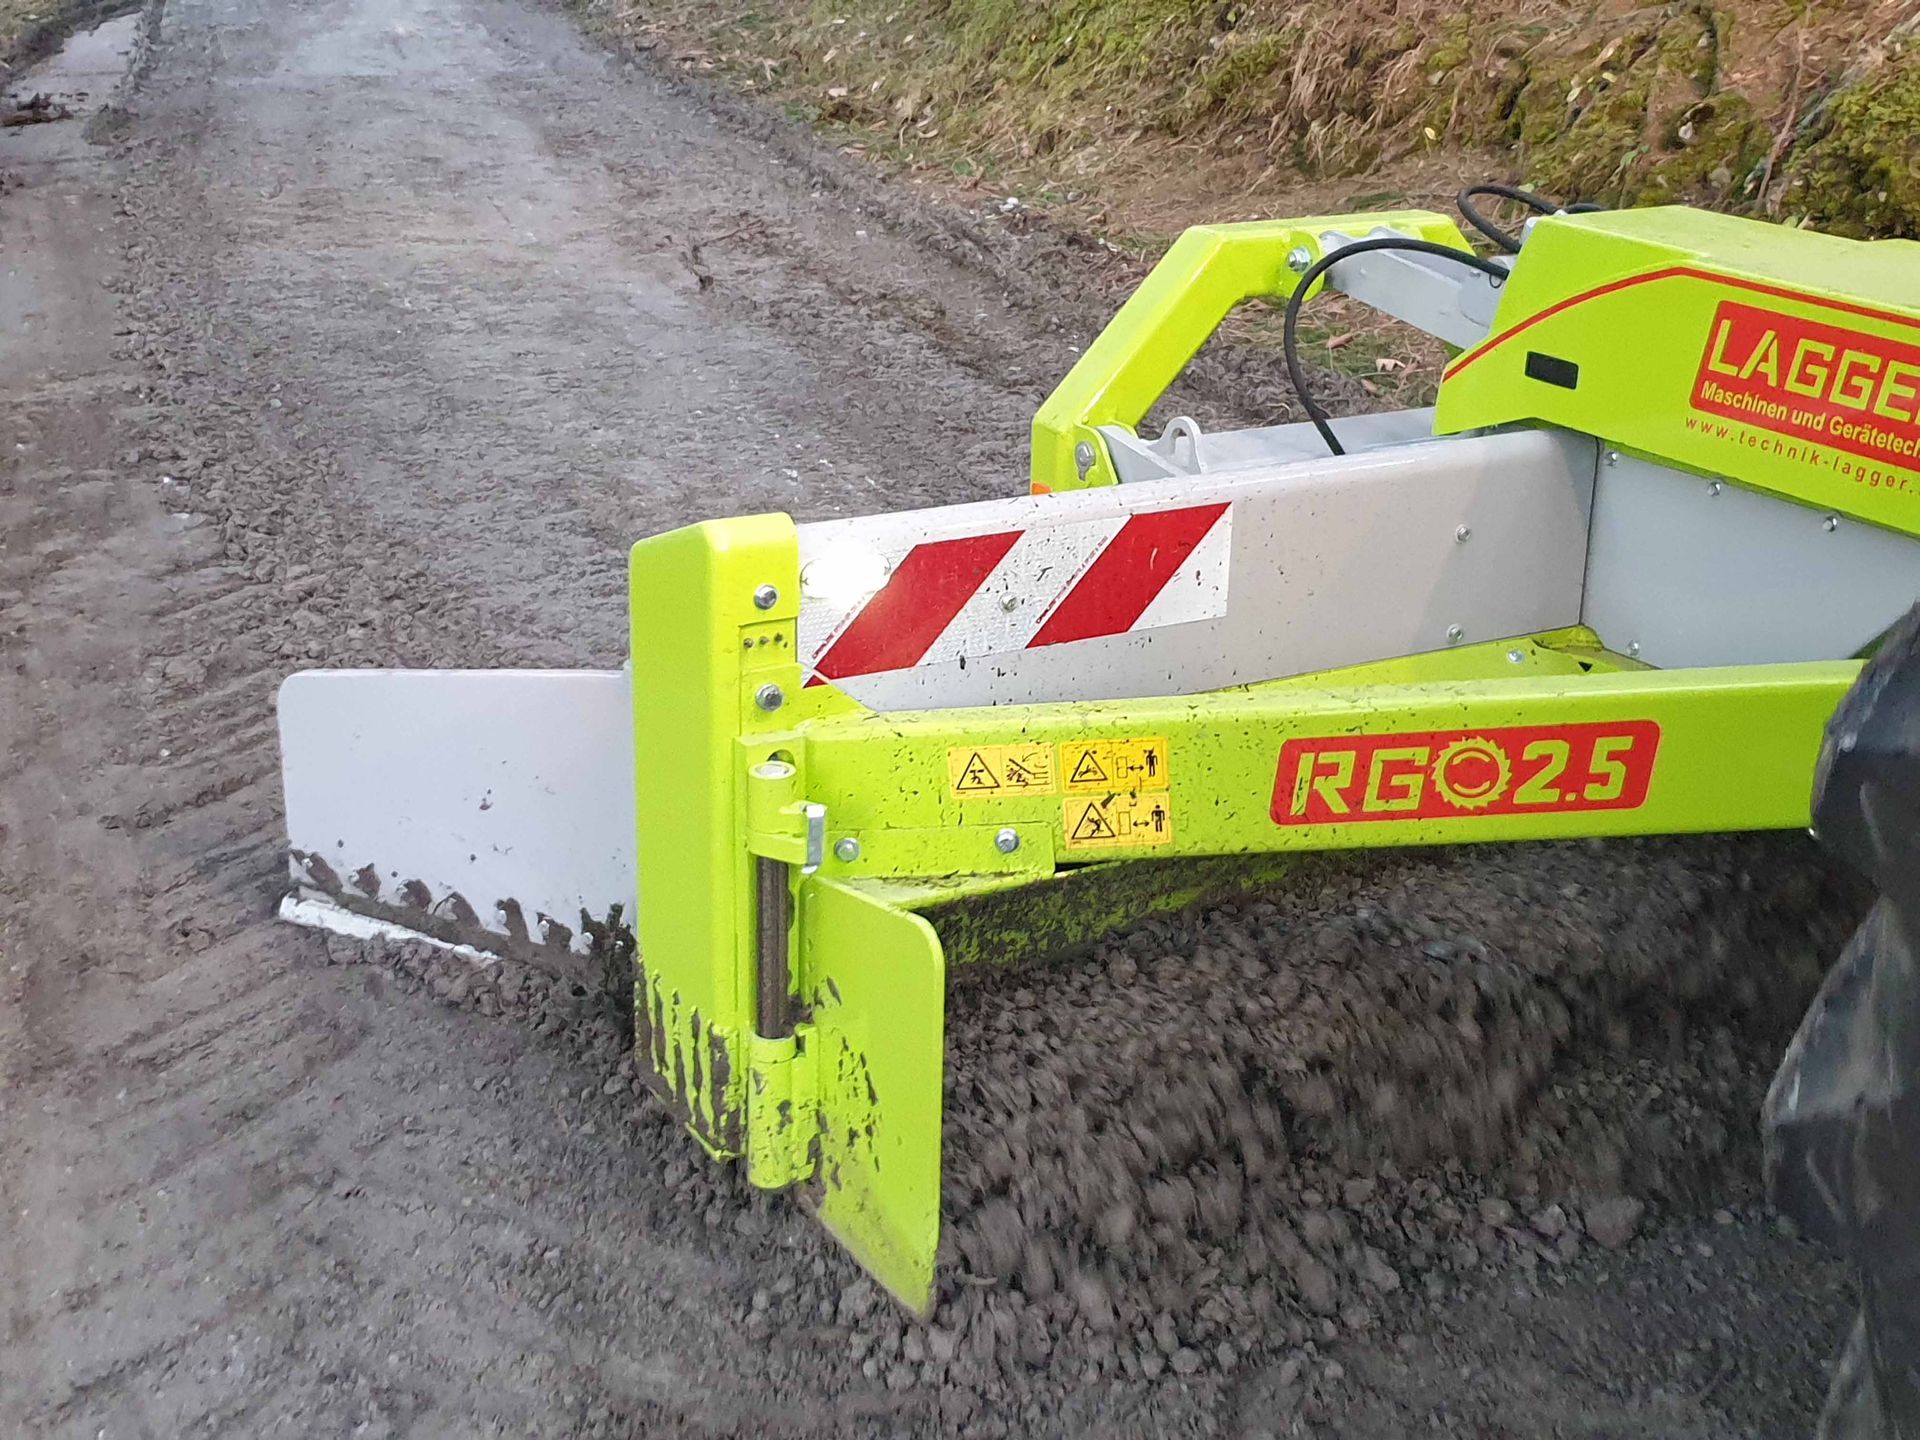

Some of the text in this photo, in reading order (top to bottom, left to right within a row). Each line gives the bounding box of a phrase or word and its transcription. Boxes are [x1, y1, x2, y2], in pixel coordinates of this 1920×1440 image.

[1701, 380, 1788, 421] Maschinen
[1791, 411, 1827, 432] und
[1708, 319, 1920, 425] LAGGE
[1685, 417, 1920, 495] www.technik-lagger.
[1513, 735, 1634, 804] 2.5
